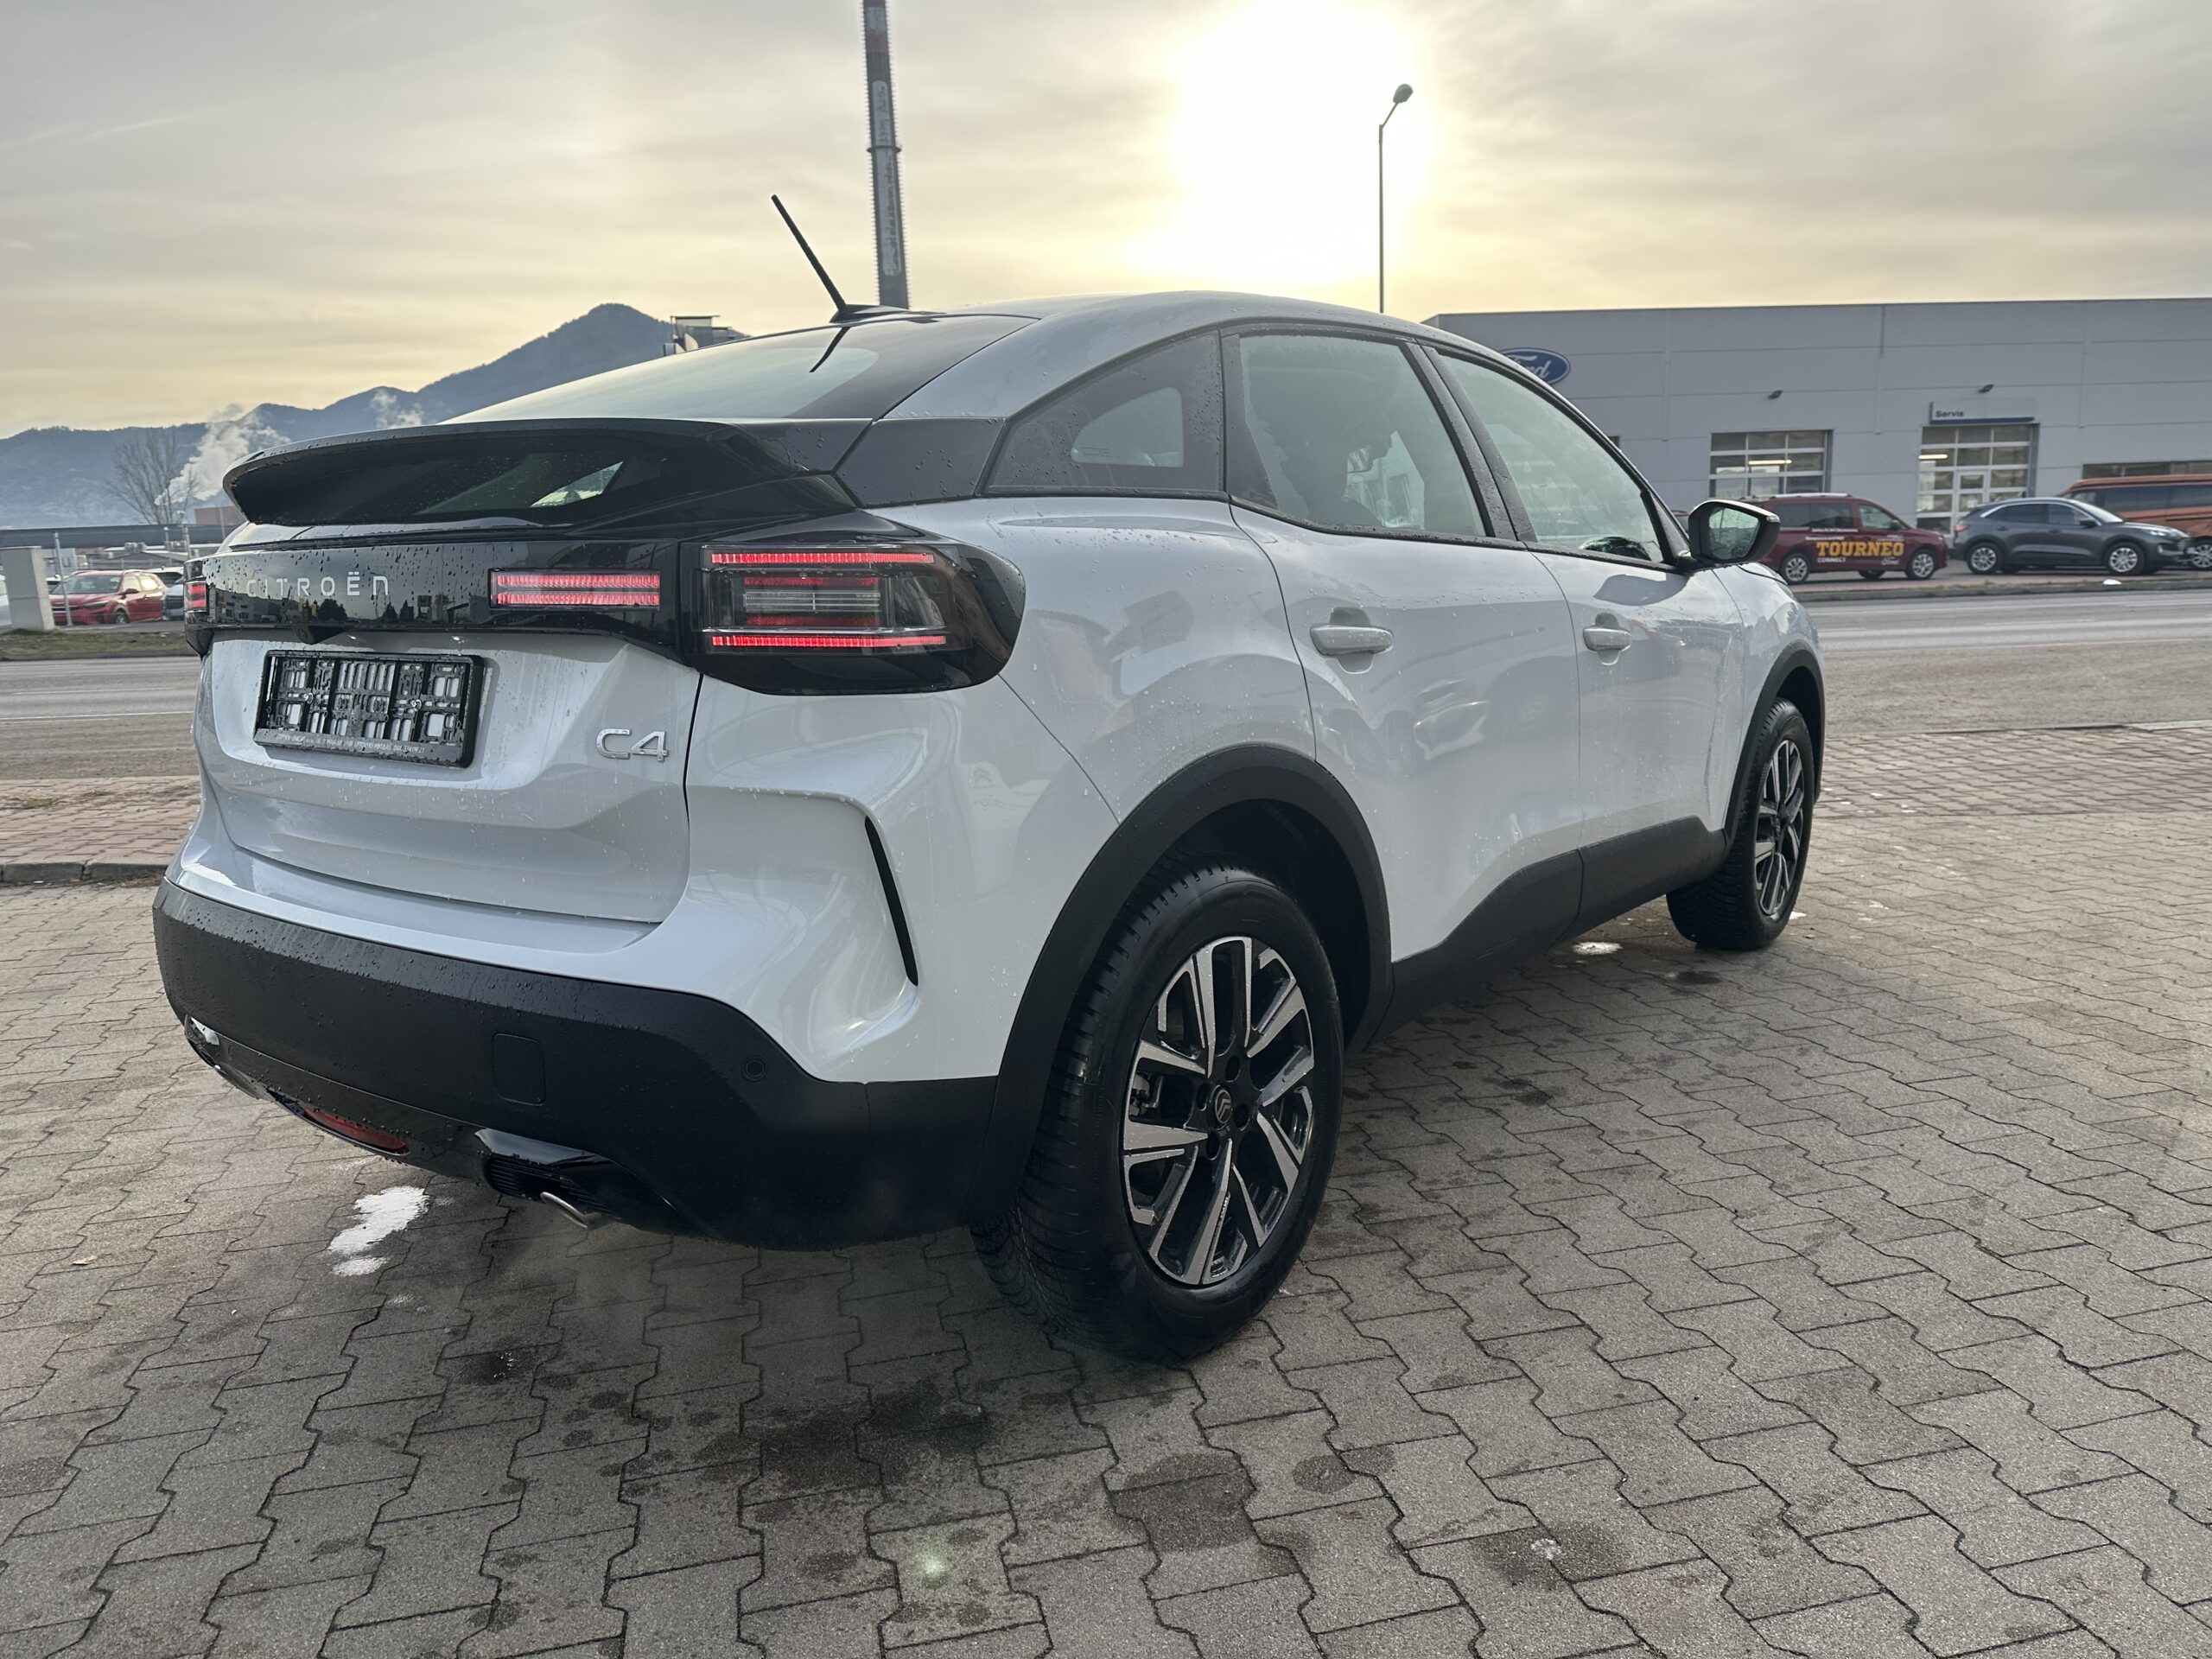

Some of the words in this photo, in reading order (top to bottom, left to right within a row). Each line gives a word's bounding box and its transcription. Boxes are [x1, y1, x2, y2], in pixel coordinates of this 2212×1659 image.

[1816, 541, 1904, 557] TOURNEO
[246, 571, 389, 598] CITROËN
[596, 728, 669, 761] C4
